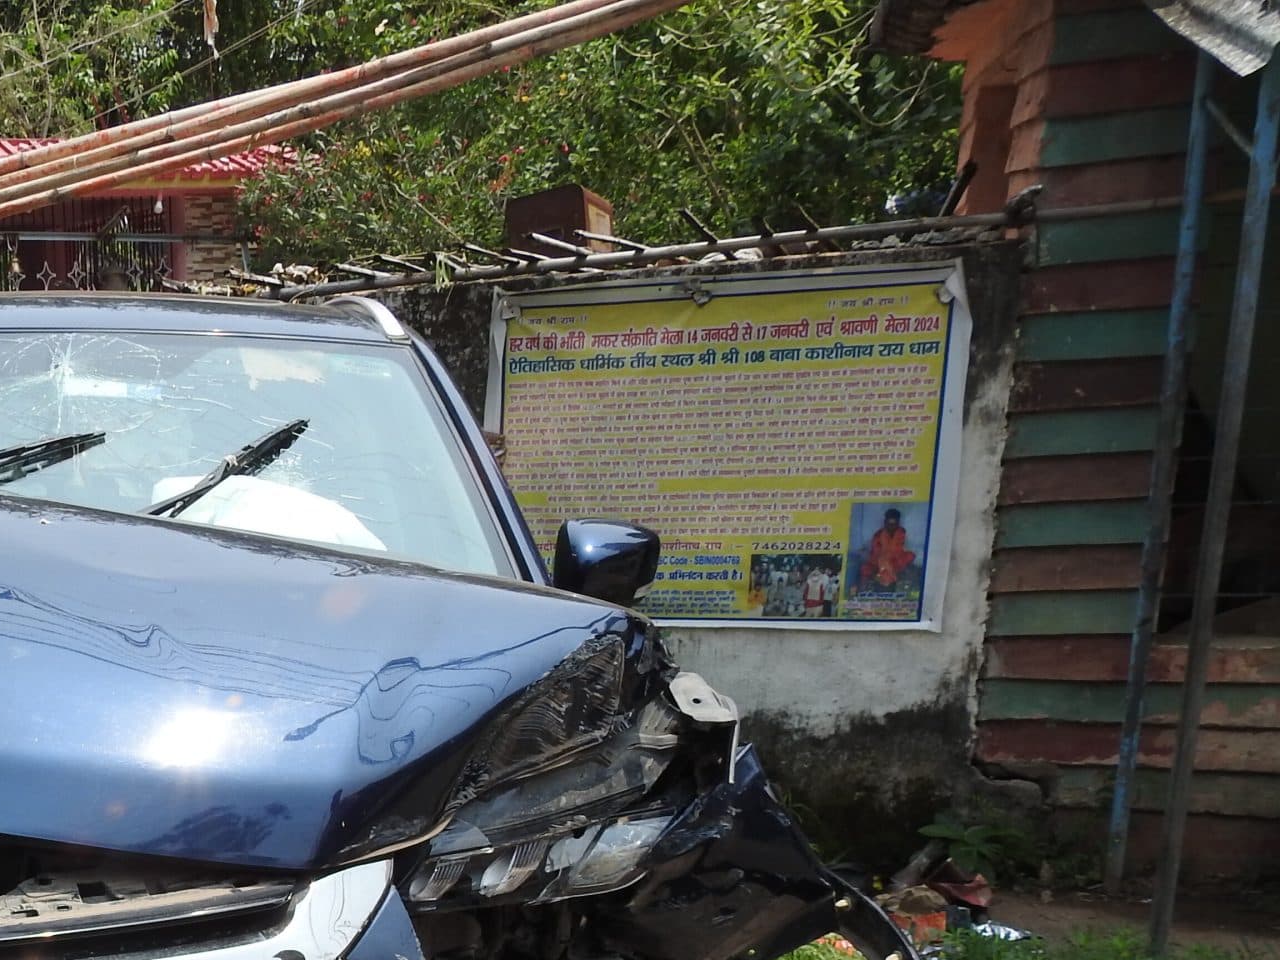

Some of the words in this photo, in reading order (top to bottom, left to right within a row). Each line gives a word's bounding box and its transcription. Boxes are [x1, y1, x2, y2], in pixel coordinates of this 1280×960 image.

[509, 337, 524, 352] हर
[525, 332, 541, 352] वर्ष
[543, 332, 558, 352] की
[591, 334, 620, 350] मकर
[660, 327, 685, 346] मेला
[687, 330, 698, 344] 14
[700, 321, 739, 344] जनवरी
[741, 323, 753, 341] से
[756, 325, 767, 339] 17
[770, 318, 810, 340] जनवरी
[816, 316, 834, 337] एवं
[840, 314, 878, 336] श्रावणी
[885, 314, 911, 334] मेला
[913, 316, 940, 333] 2024
[509, 355, 577, 375] ऐतिहासिक
[579, 351, 626, 371] धार्मिक
[661, 351, 694, 368] स्थल
[698, 348, 716, 367] श्री
[721, 347, 739, 365] श्री
[744, 349, 765, 364] 108
[770, 346, 800, 362] बाबा
[804, 340, 873, 361] काशीनाथ
[878, 343, 905, 357] राय
[908, 340, 941, 355] धाम
[670, 555, 688, 565] Code
